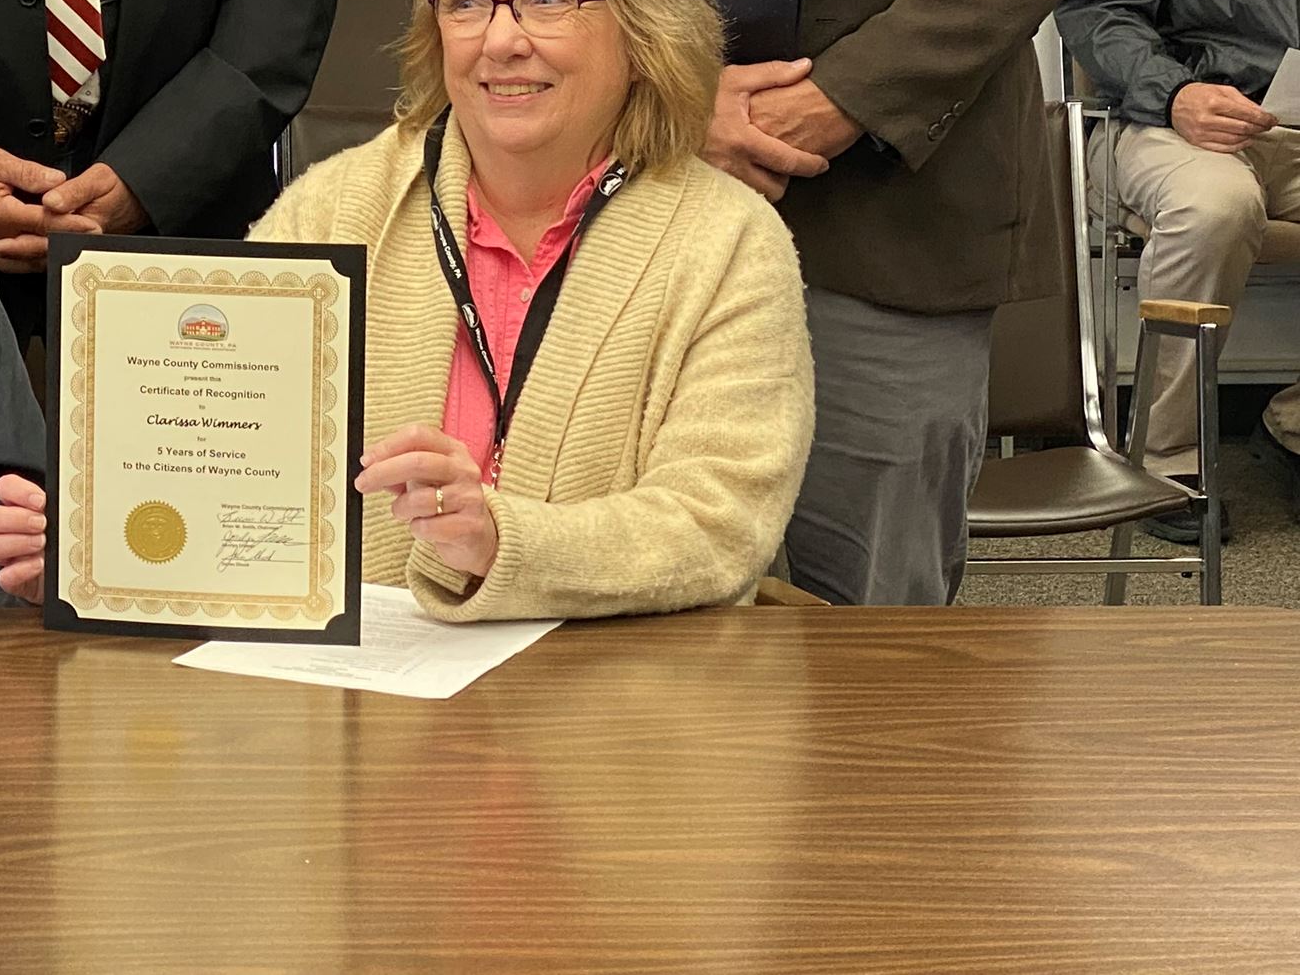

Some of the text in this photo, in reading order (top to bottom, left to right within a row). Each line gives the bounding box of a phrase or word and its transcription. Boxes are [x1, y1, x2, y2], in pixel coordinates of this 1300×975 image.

[127, 356, 280, 372] Wayne County Commissioners
[184, 375, 208, 383] present
[140, 385, 266, 400] Certificate of Recognition
[147, 414, 262, 430] Clarissa Wimmers
[157, 447, 246, 459] 5 Years of Service
[123, 462, 281, 479] to the Citizens of Wayne County
